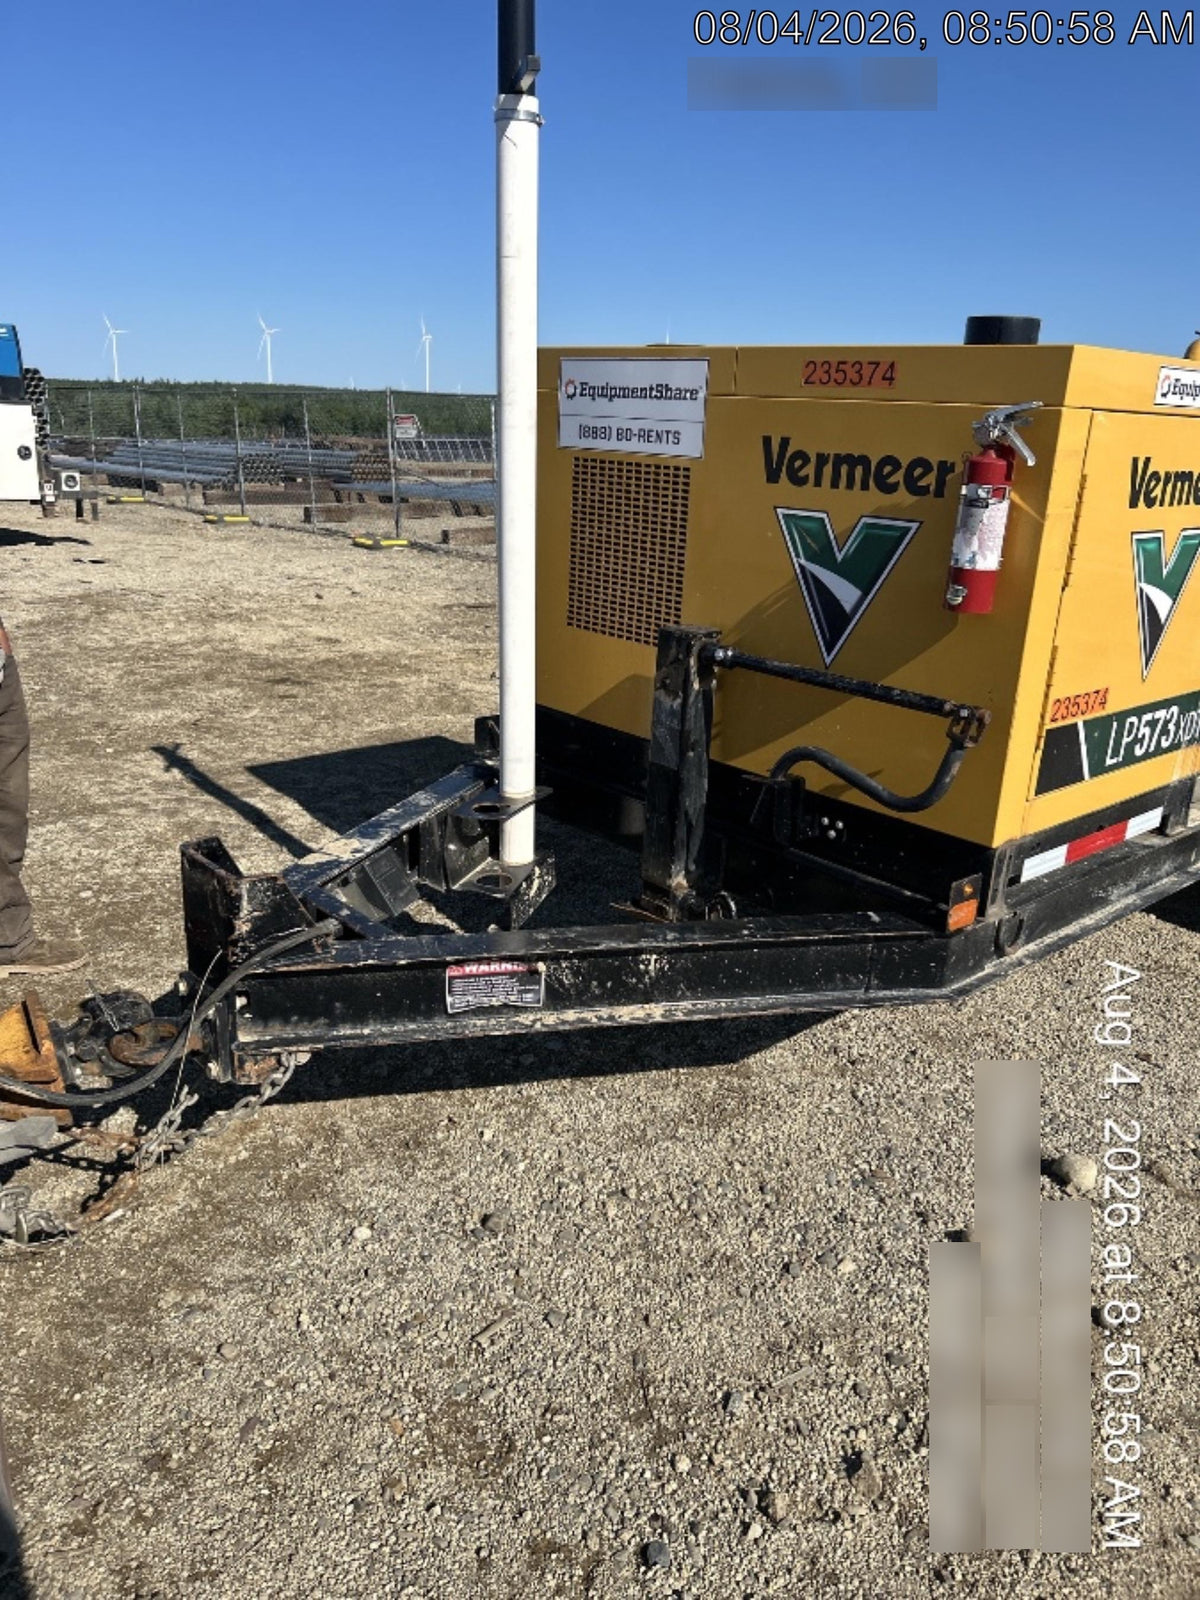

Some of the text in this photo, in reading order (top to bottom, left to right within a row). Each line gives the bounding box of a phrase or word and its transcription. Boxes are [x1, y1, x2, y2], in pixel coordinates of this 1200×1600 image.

[803, 360, 896, 386] 235374
[579, 382, 699, 402] EquipmentShare
[761, 435, 956, 498] Vermeer
[1050, 688, 1109, 722] 235374
